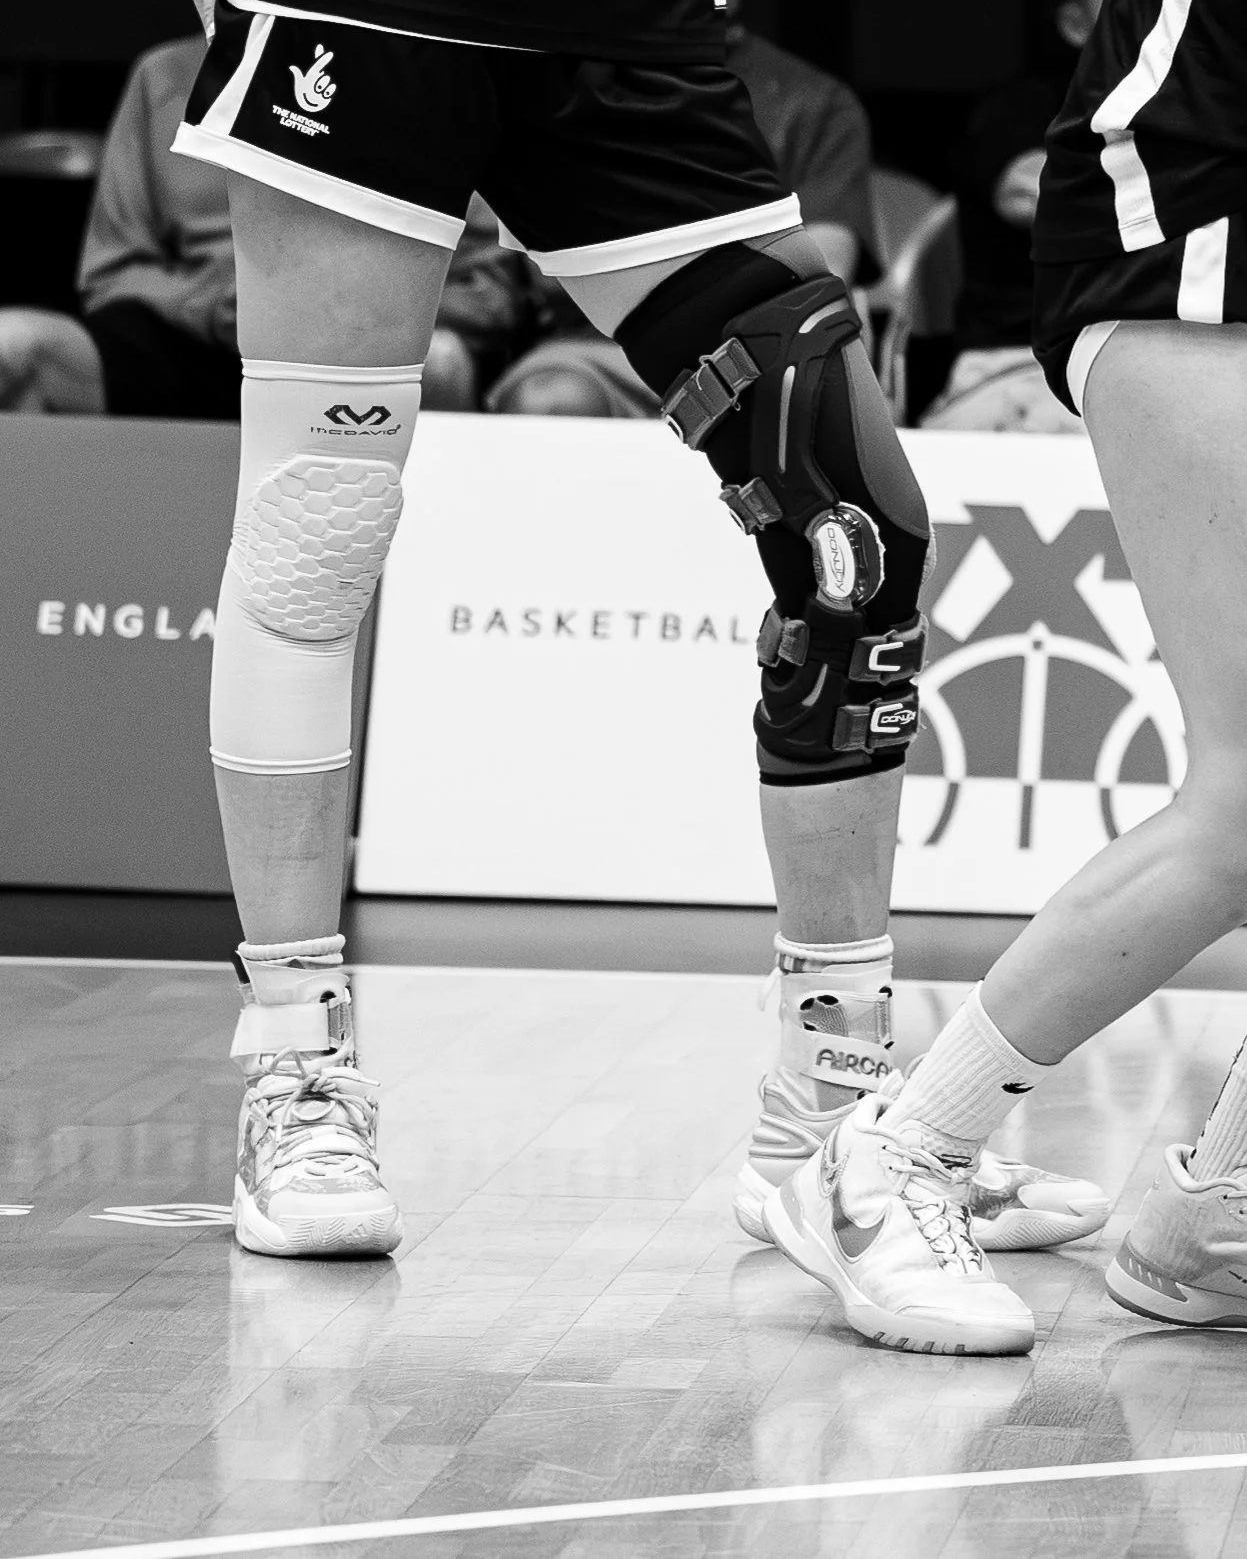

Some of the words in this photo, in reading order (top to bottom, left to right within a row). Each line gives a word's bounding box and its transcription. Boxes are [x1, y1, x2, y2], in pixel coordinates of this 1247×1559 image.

[272, 104, 291, 119] THE
[289, 111, 331, 135] NATIONAL
[280, 117, 320, 137] LOTTERY
[37, 600, 217, 641] ENGLA
[450, 605, 750, 645] BASKETBAL
[816, 1048, 894, 1079] AIRCA
